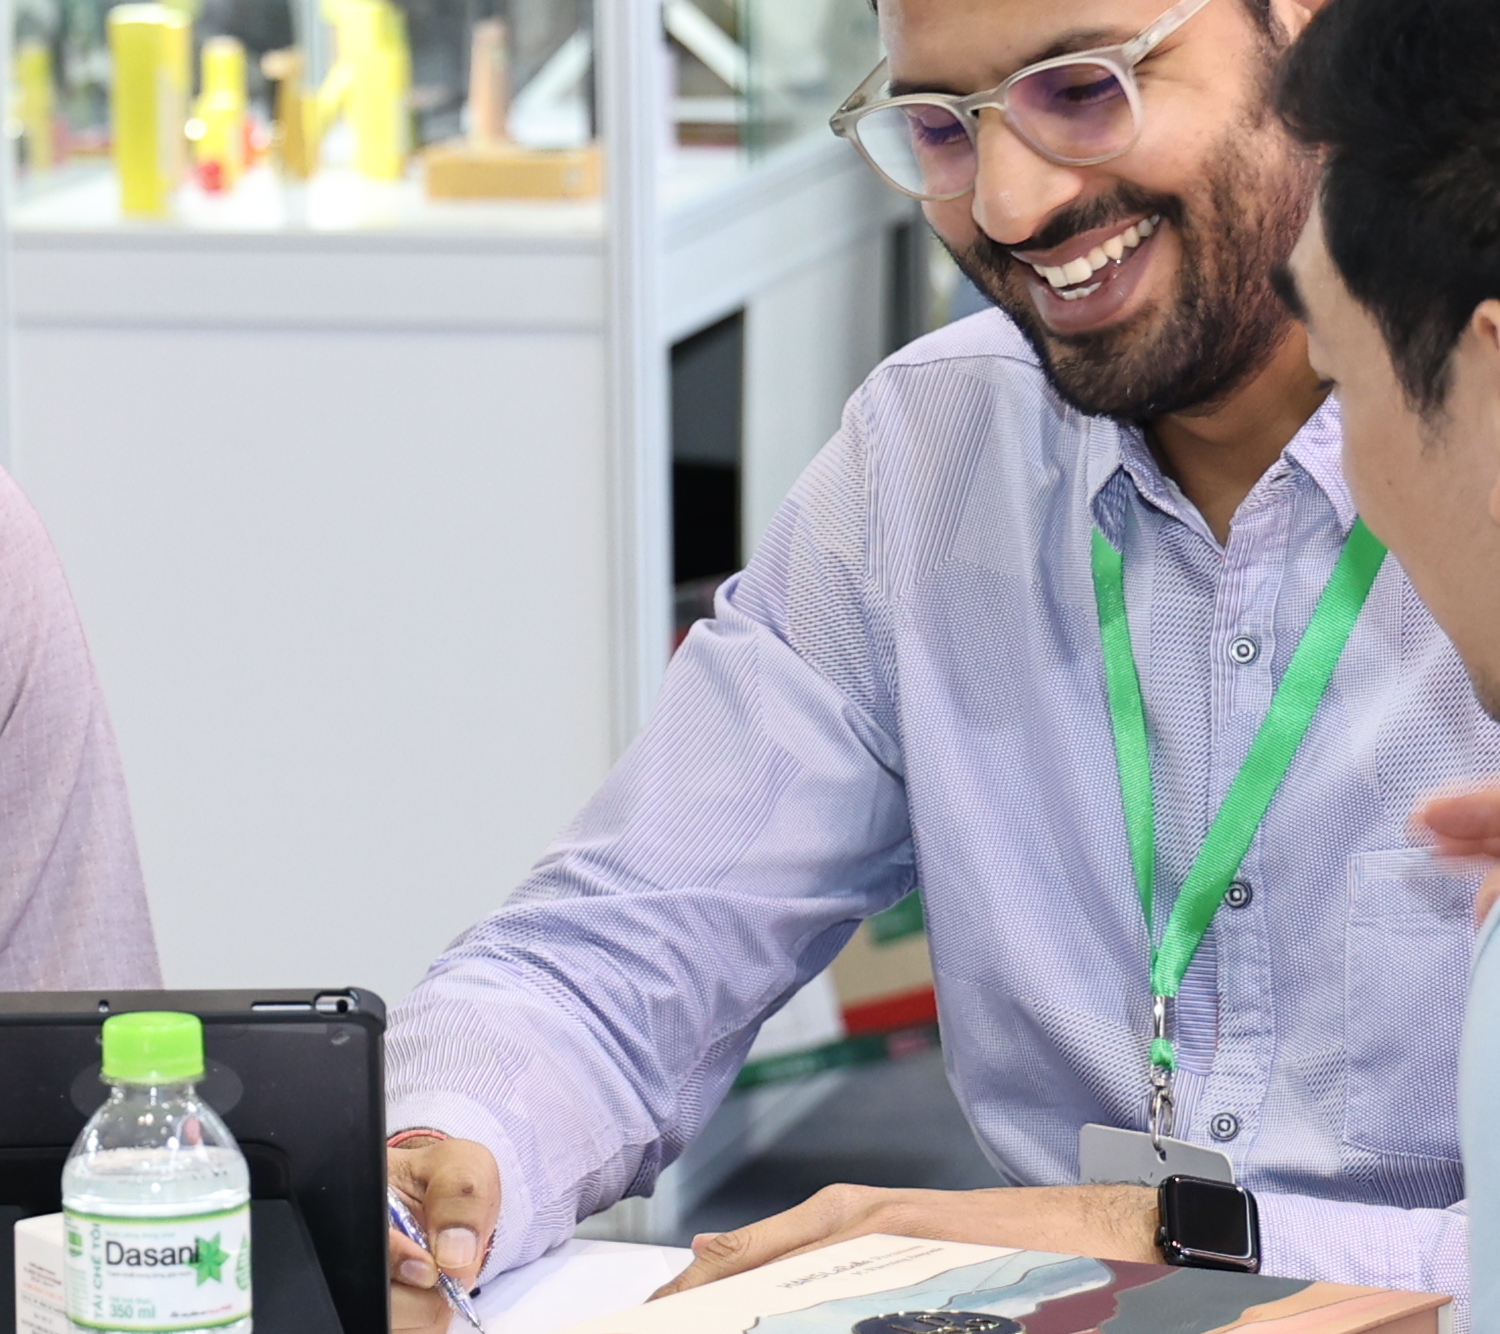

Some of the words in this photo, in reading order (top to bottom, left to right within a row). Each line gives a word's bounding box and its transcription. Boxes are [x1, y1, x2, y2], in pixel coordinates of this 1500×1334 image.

[105, 1237, 200, 1267] Dasani
[109, 1303, 134, 1319] 350
[138, 1303, 156, 1319] ml
